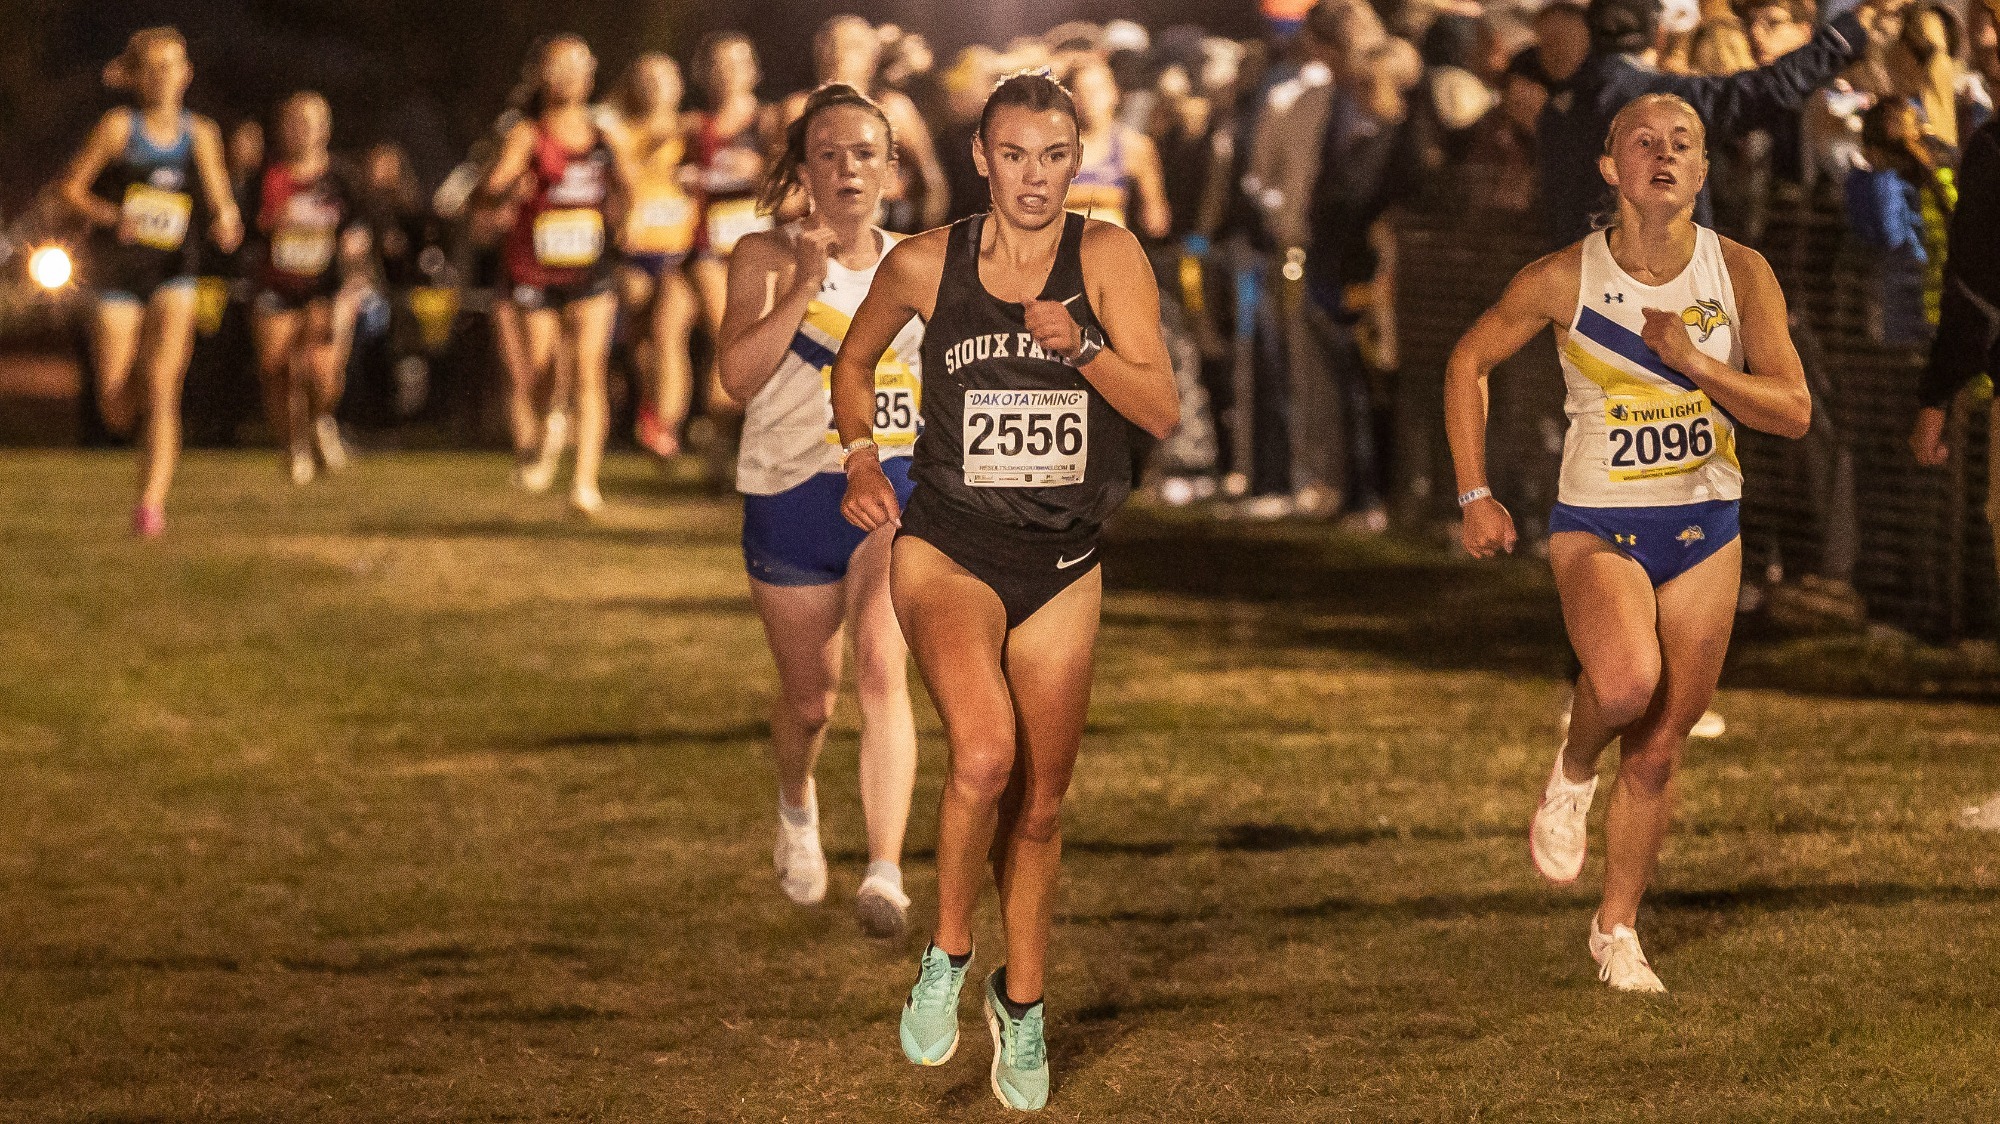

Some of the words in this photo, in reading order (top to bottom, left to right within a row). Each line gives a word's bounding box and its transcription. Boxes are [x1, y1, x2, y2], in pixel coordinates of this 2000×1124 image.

[945, 333, 1010, 375] SIOUX
[972, 393, 1079, 406] DAKOTATIMING
[1631, 401, 1703, 422] TWILIGHT
[968, 412, 1083, 456] 2556
[1609, 417, 1713, 467] 2096
